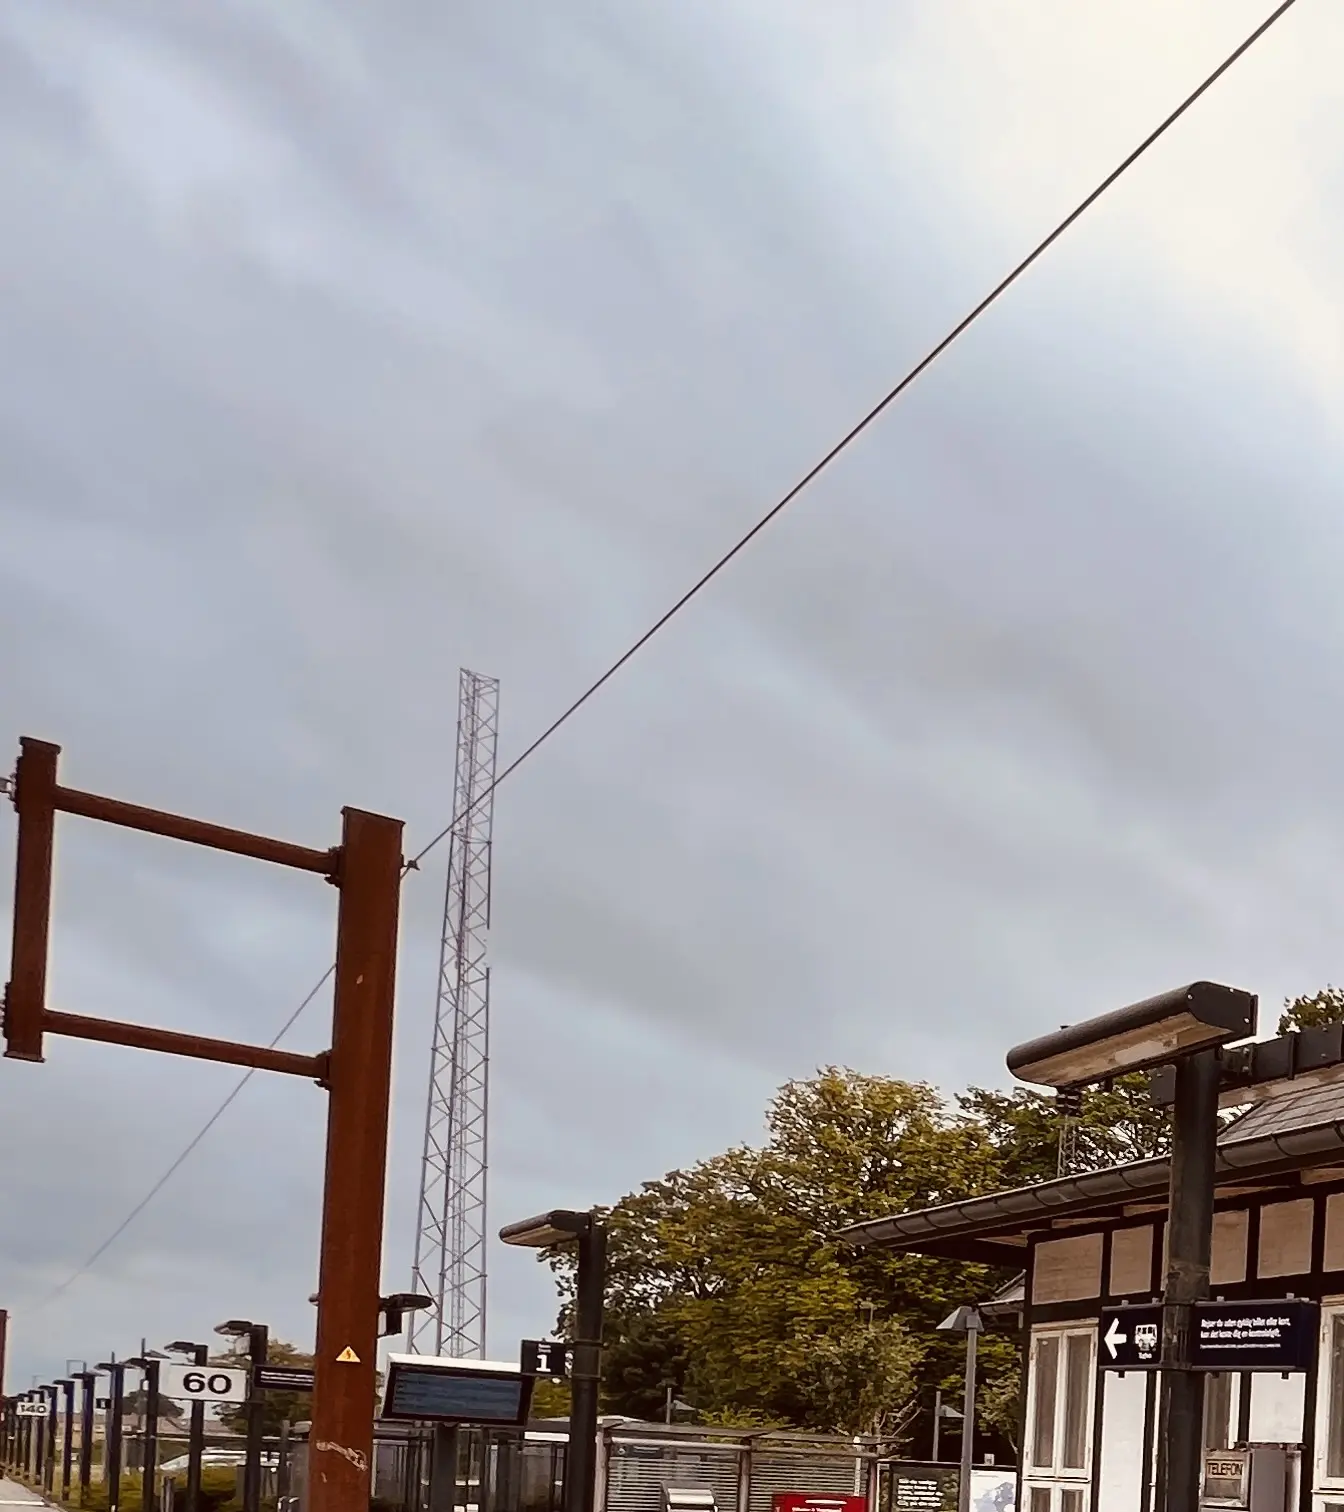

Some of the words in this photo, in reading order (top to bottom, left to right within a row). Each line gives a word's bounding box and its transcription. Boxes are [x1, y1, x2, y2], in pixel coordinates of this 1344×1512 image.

[535, 1354, 552, 1373] 1
[182, 1371, 233, 1395] 60
[19, 1404, 47, 1414] 140
[1207, 1462, 1244, 1476] TELEFON
